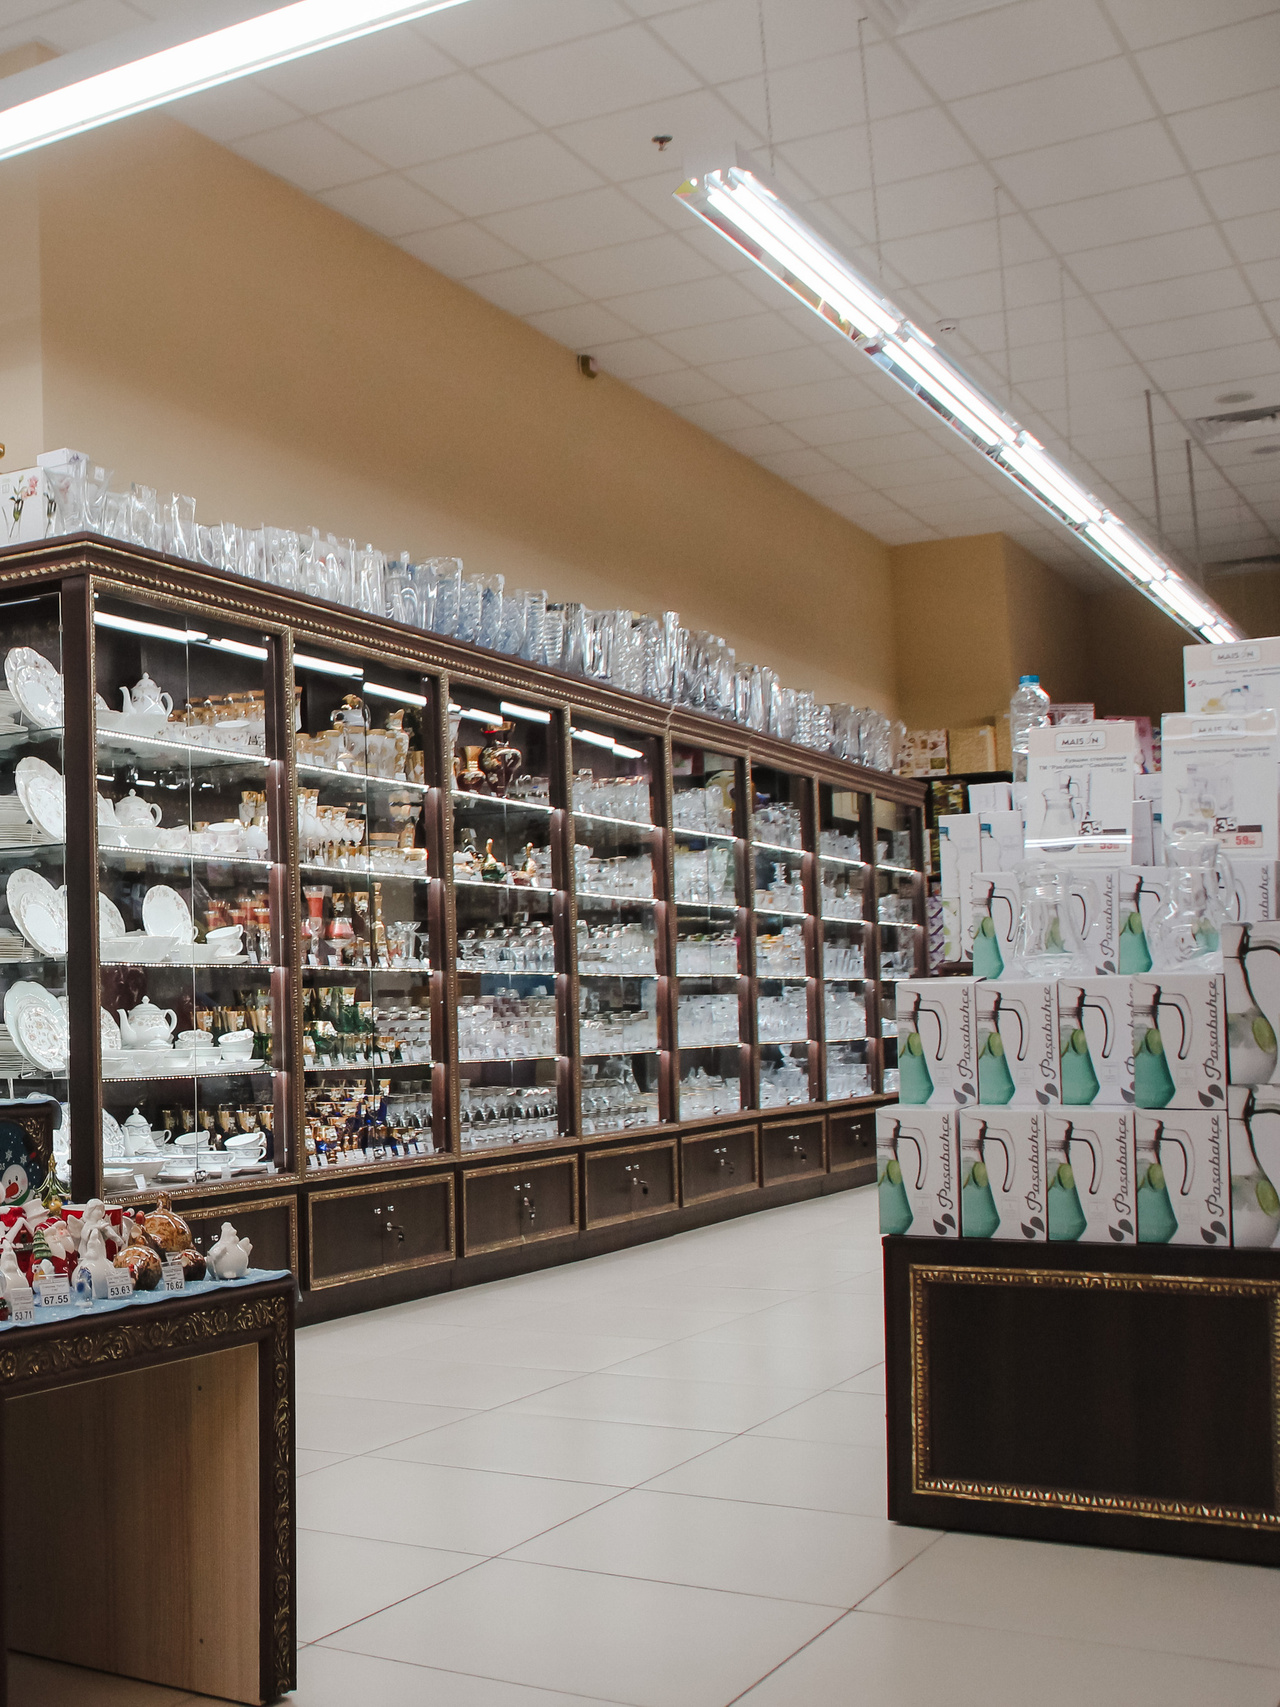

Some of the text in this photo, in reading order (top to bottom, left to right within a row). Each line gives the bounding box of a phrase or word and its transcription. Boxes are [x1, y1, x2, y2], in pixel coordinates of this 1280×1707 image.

[110, 1285, 131, 1297] 53.63
[43, 1294, 69, 1305] 67.55
[15, 1310, 32, 1320] 53.71
